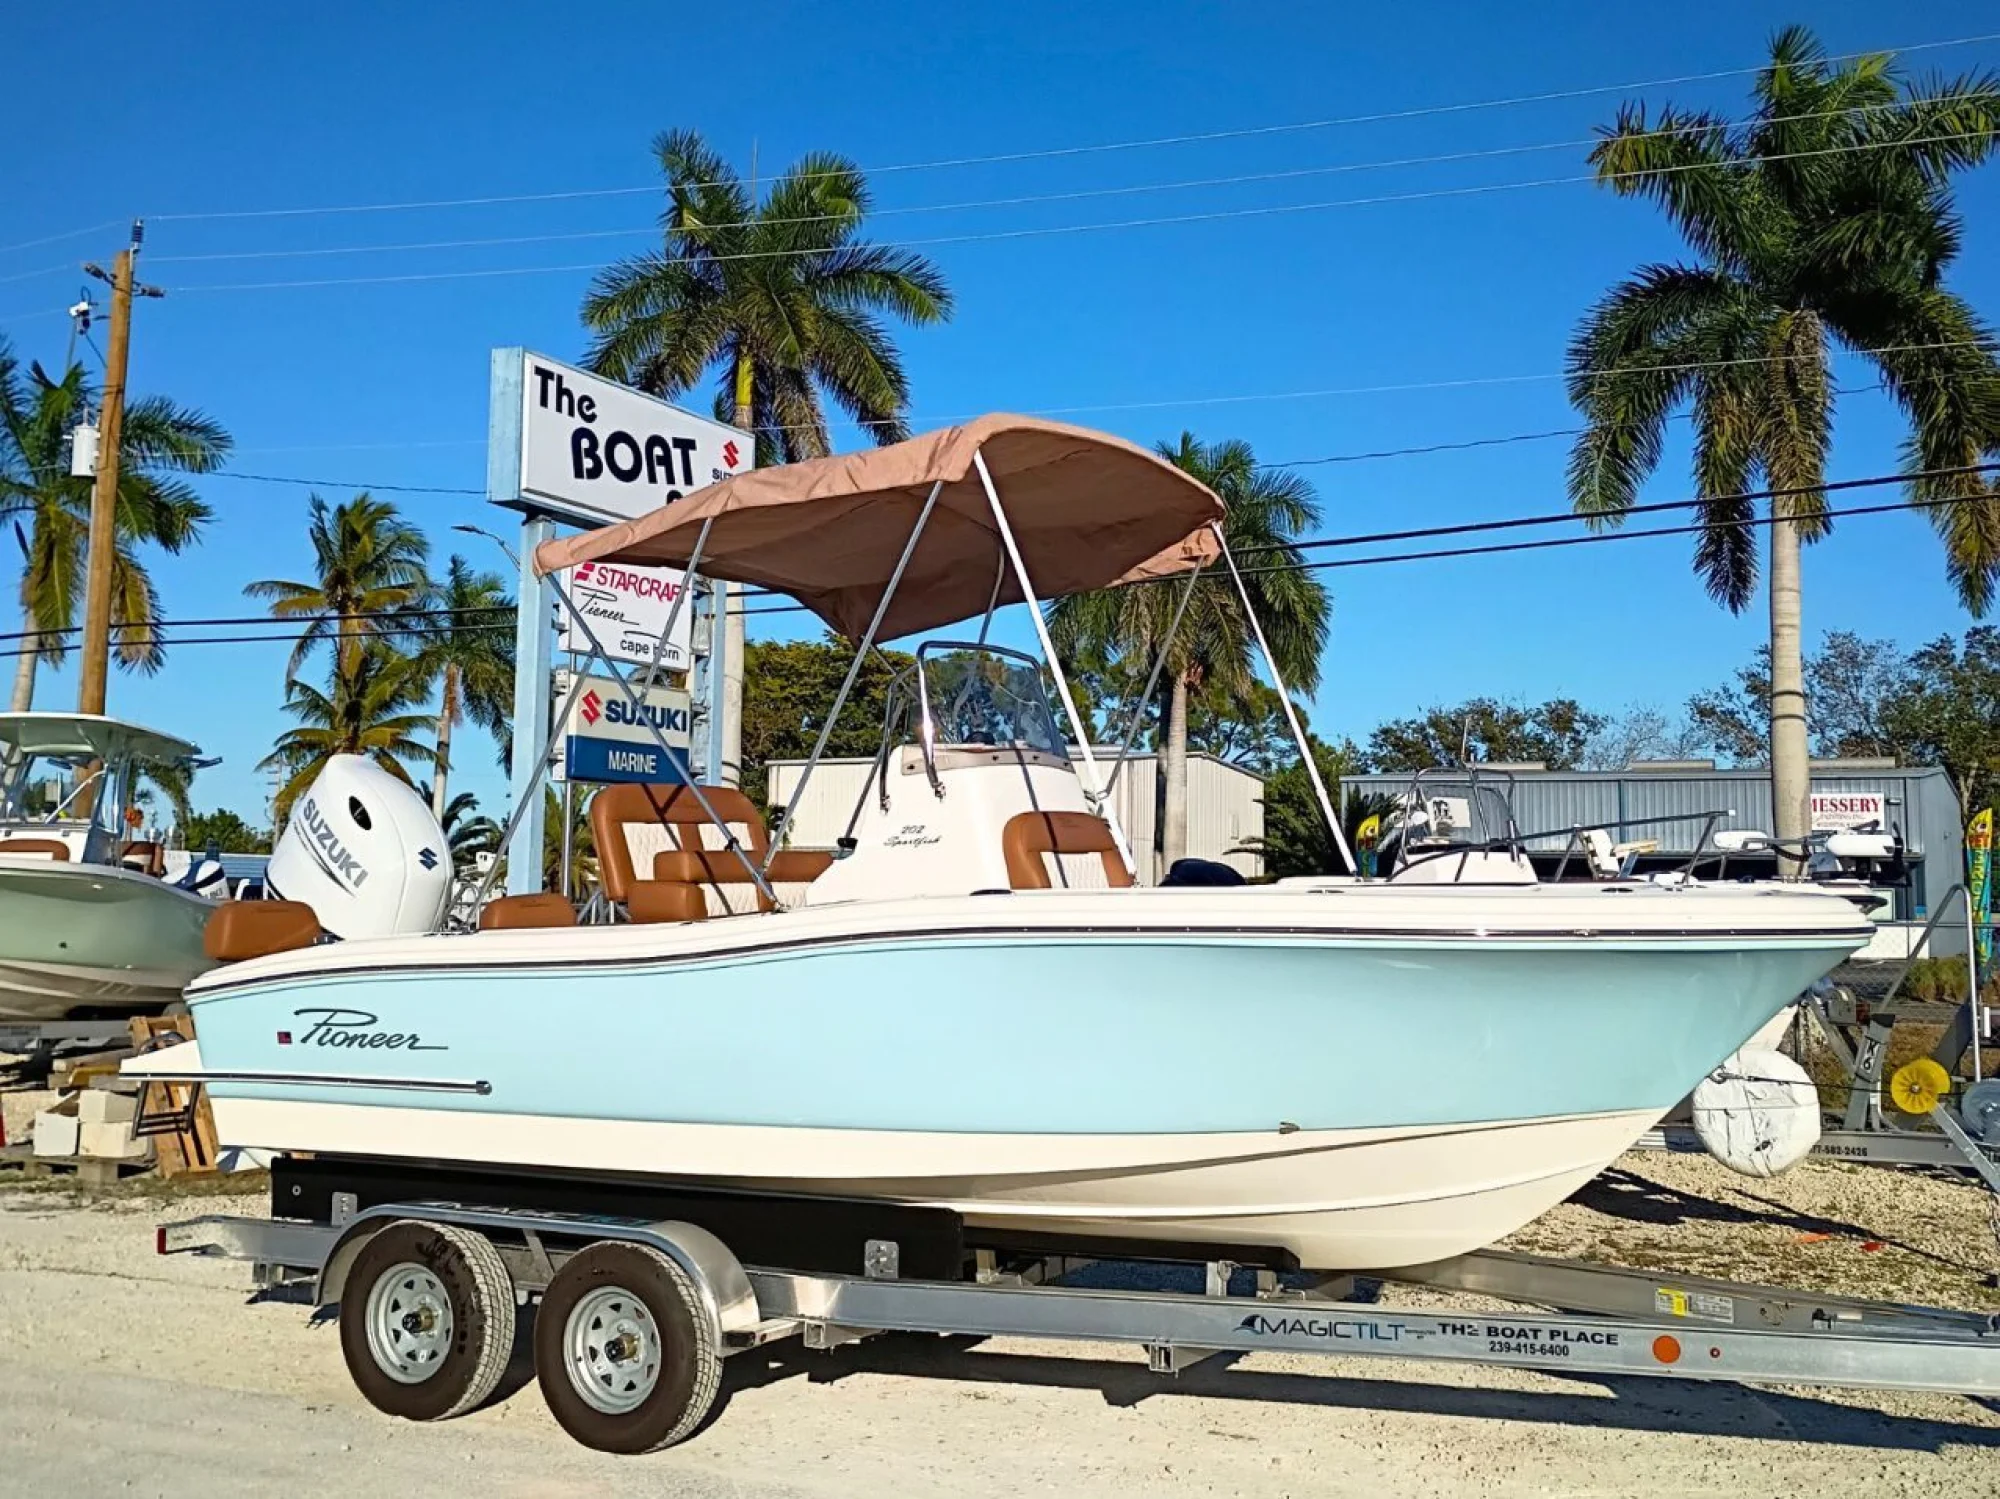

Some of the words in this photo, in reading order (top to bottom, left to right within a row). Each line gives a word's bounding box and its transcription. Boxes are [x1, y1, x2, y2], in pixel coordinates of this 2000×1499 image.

[534, 364, 598, 424] The
[571, 426, 697, 487] BOAT
[596, 566, 689, 602] STARCRAF
[620, 638, 649, 656] cape
[605, 699, 687, 733] SUZUKI
[608, 749, 657, 775] MARINE
[303, 798, 369, 889] SUZUKI
[293, 1007, 449, 1051] Pioneer
[1260, 1317, 1406, 1342] MAGICTILT
[1486, 1326, 1542, 1341] BOAT
[1549, 1329, 1620, 1346] PLACE
[1488, 1340, 1571, 1357] 239-415-6400
